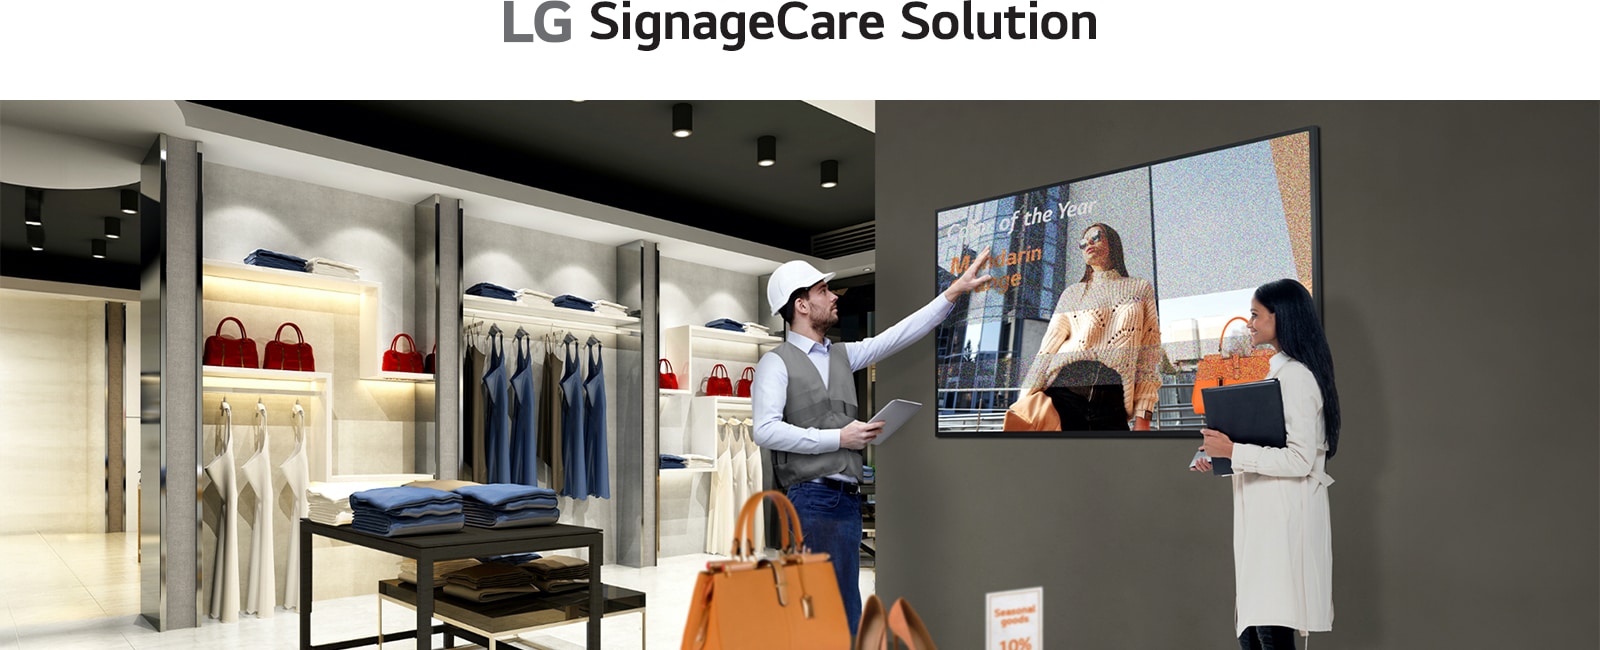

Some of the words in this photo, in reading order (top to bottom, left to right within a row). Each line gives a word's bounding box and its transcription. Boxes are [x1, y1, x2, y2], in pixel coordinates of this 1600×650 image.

[998, 210, 1021, 236] of
[1024, 206, 1053, 227] the
[1058, 200, 1098, 220] Year
[950, 245, 1042, 275] Mndarin
[951, 272, 1022, 295] ange
[994, 604, 1036, 618] Seasonal
[1001, 615, 1029, 628] goods
[999, 636, 1032, 650] 10%
